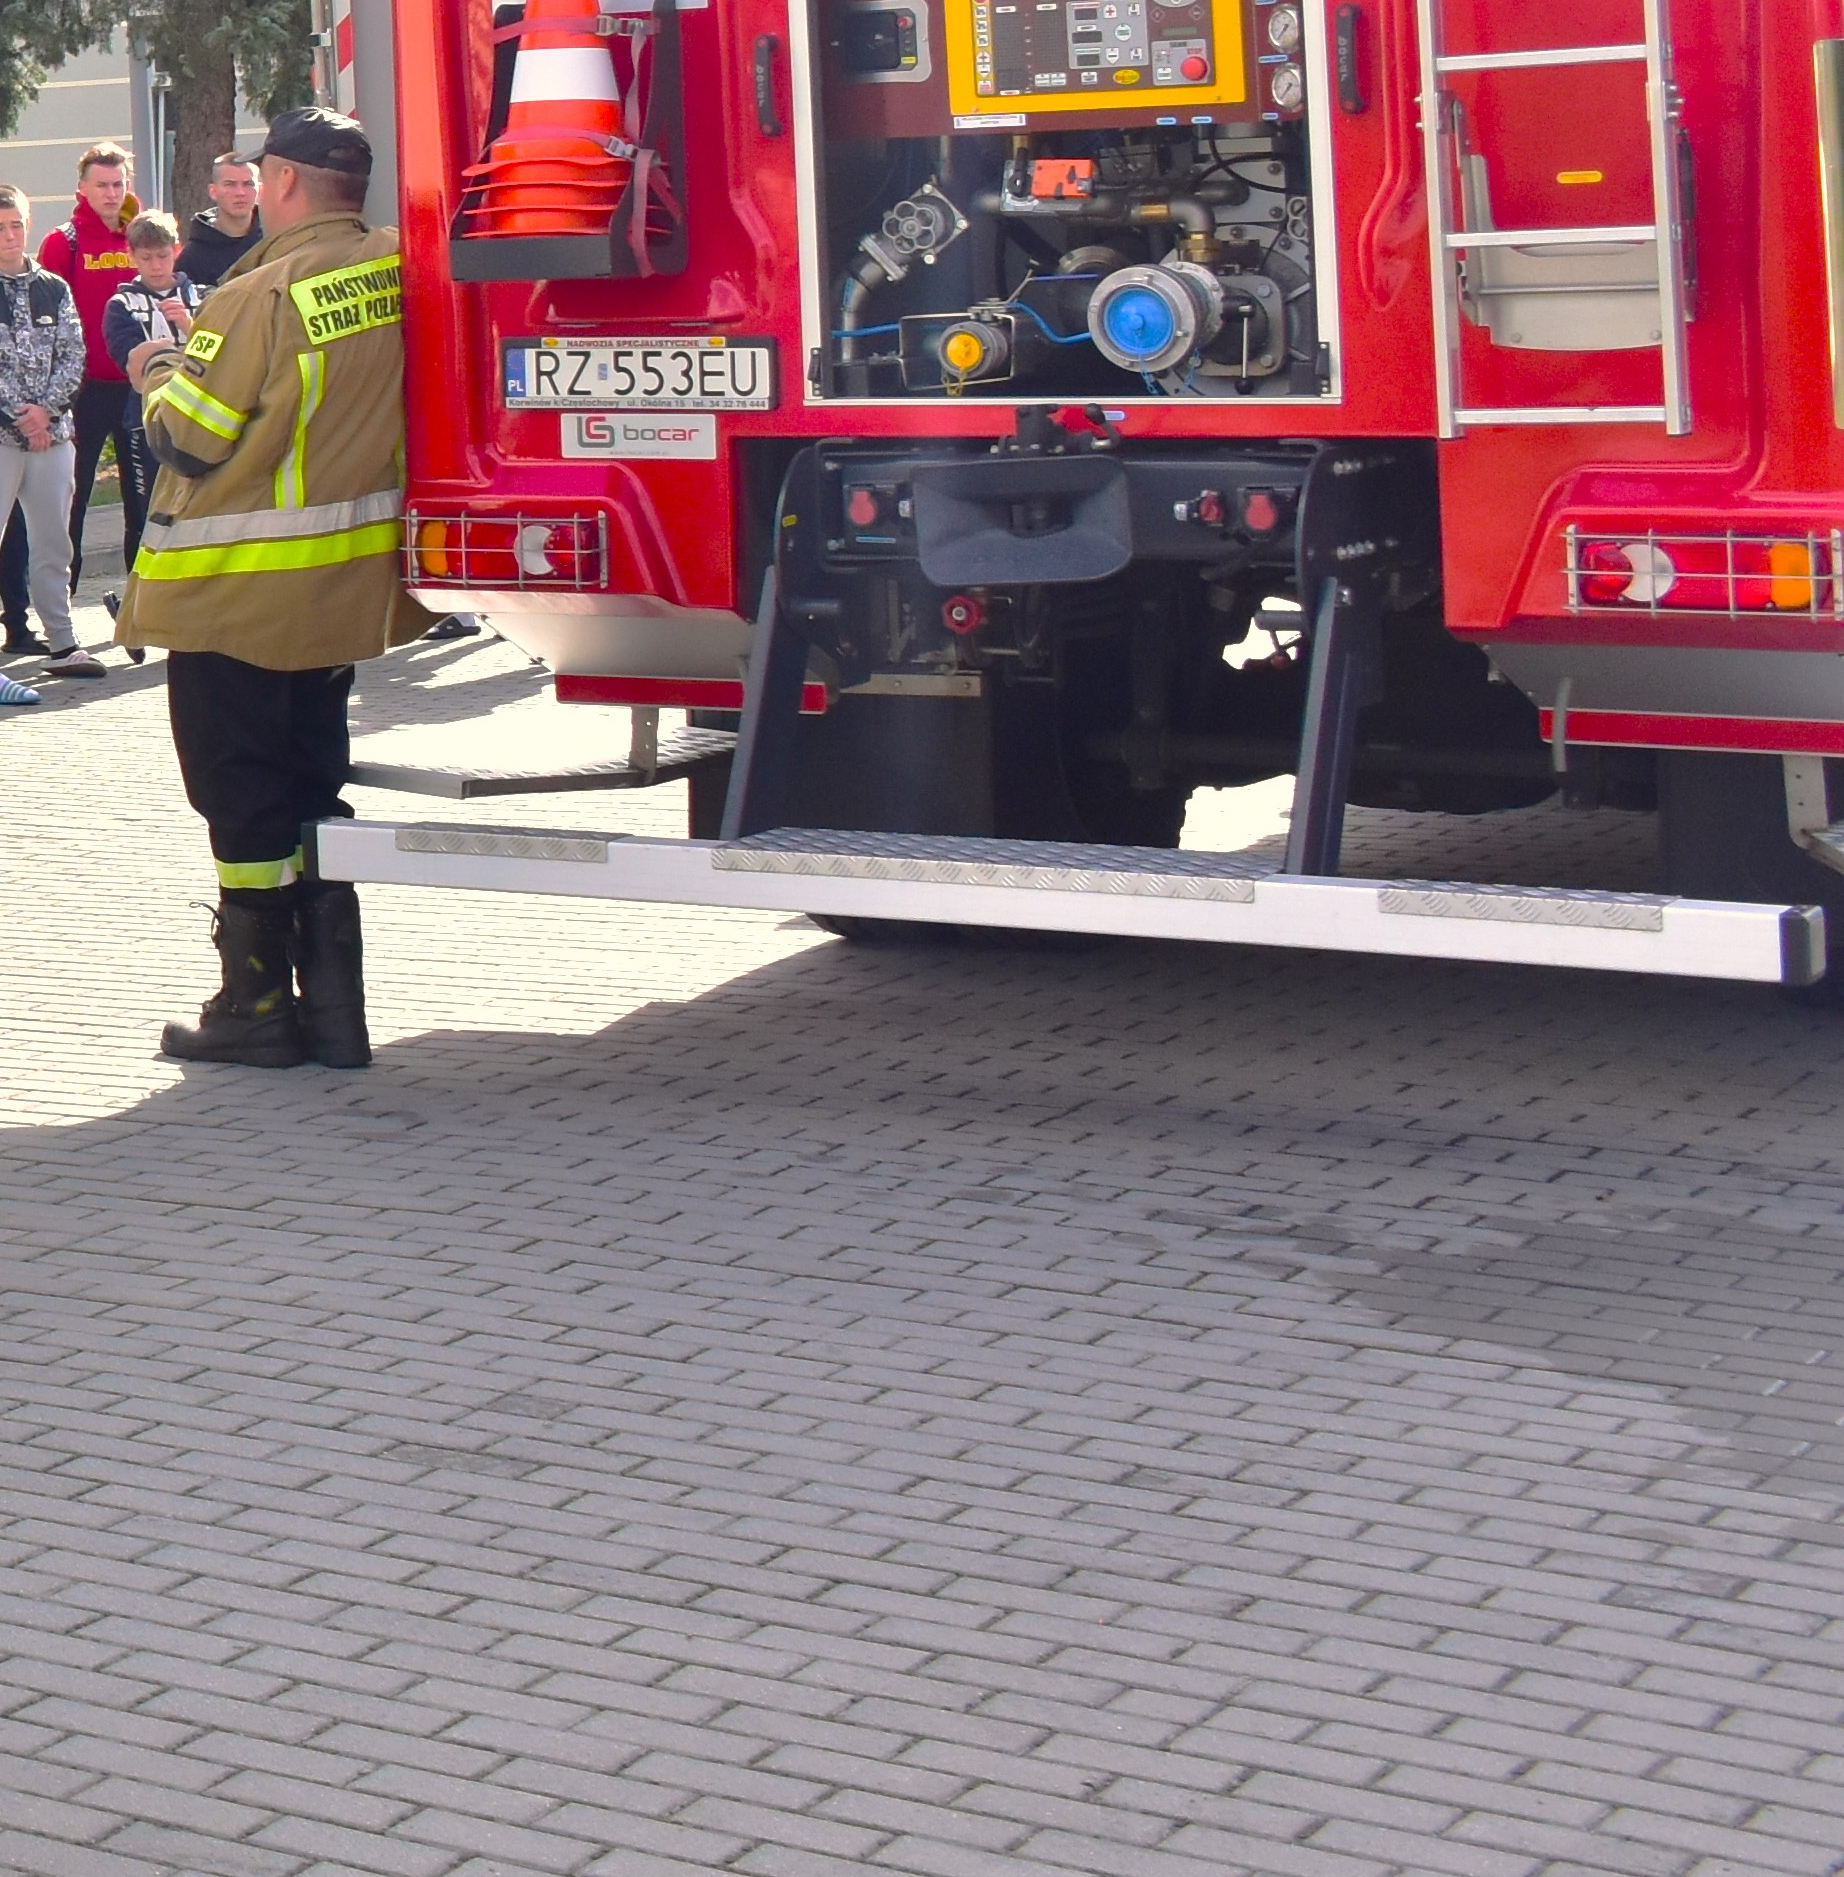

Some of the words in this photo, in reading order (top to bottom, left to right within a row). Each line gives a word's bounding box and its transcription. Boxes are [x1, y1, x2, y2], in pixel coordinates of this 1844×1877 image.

[190, 335, 216, 354] PSP
[566, 339, 614, 348] NADWOZIA
[615, 339, 700, 348] SPECJALISTYCZNE
[507, 379, 524, 392] PL
[534, 350, 593, 396] RZ
[612, 350, 758, 397] 553EU
[562, 398, 620, 409] Częstochowy
[640, 398, 672, 408] Okólna
[623, 423, 700, 441] bocar
